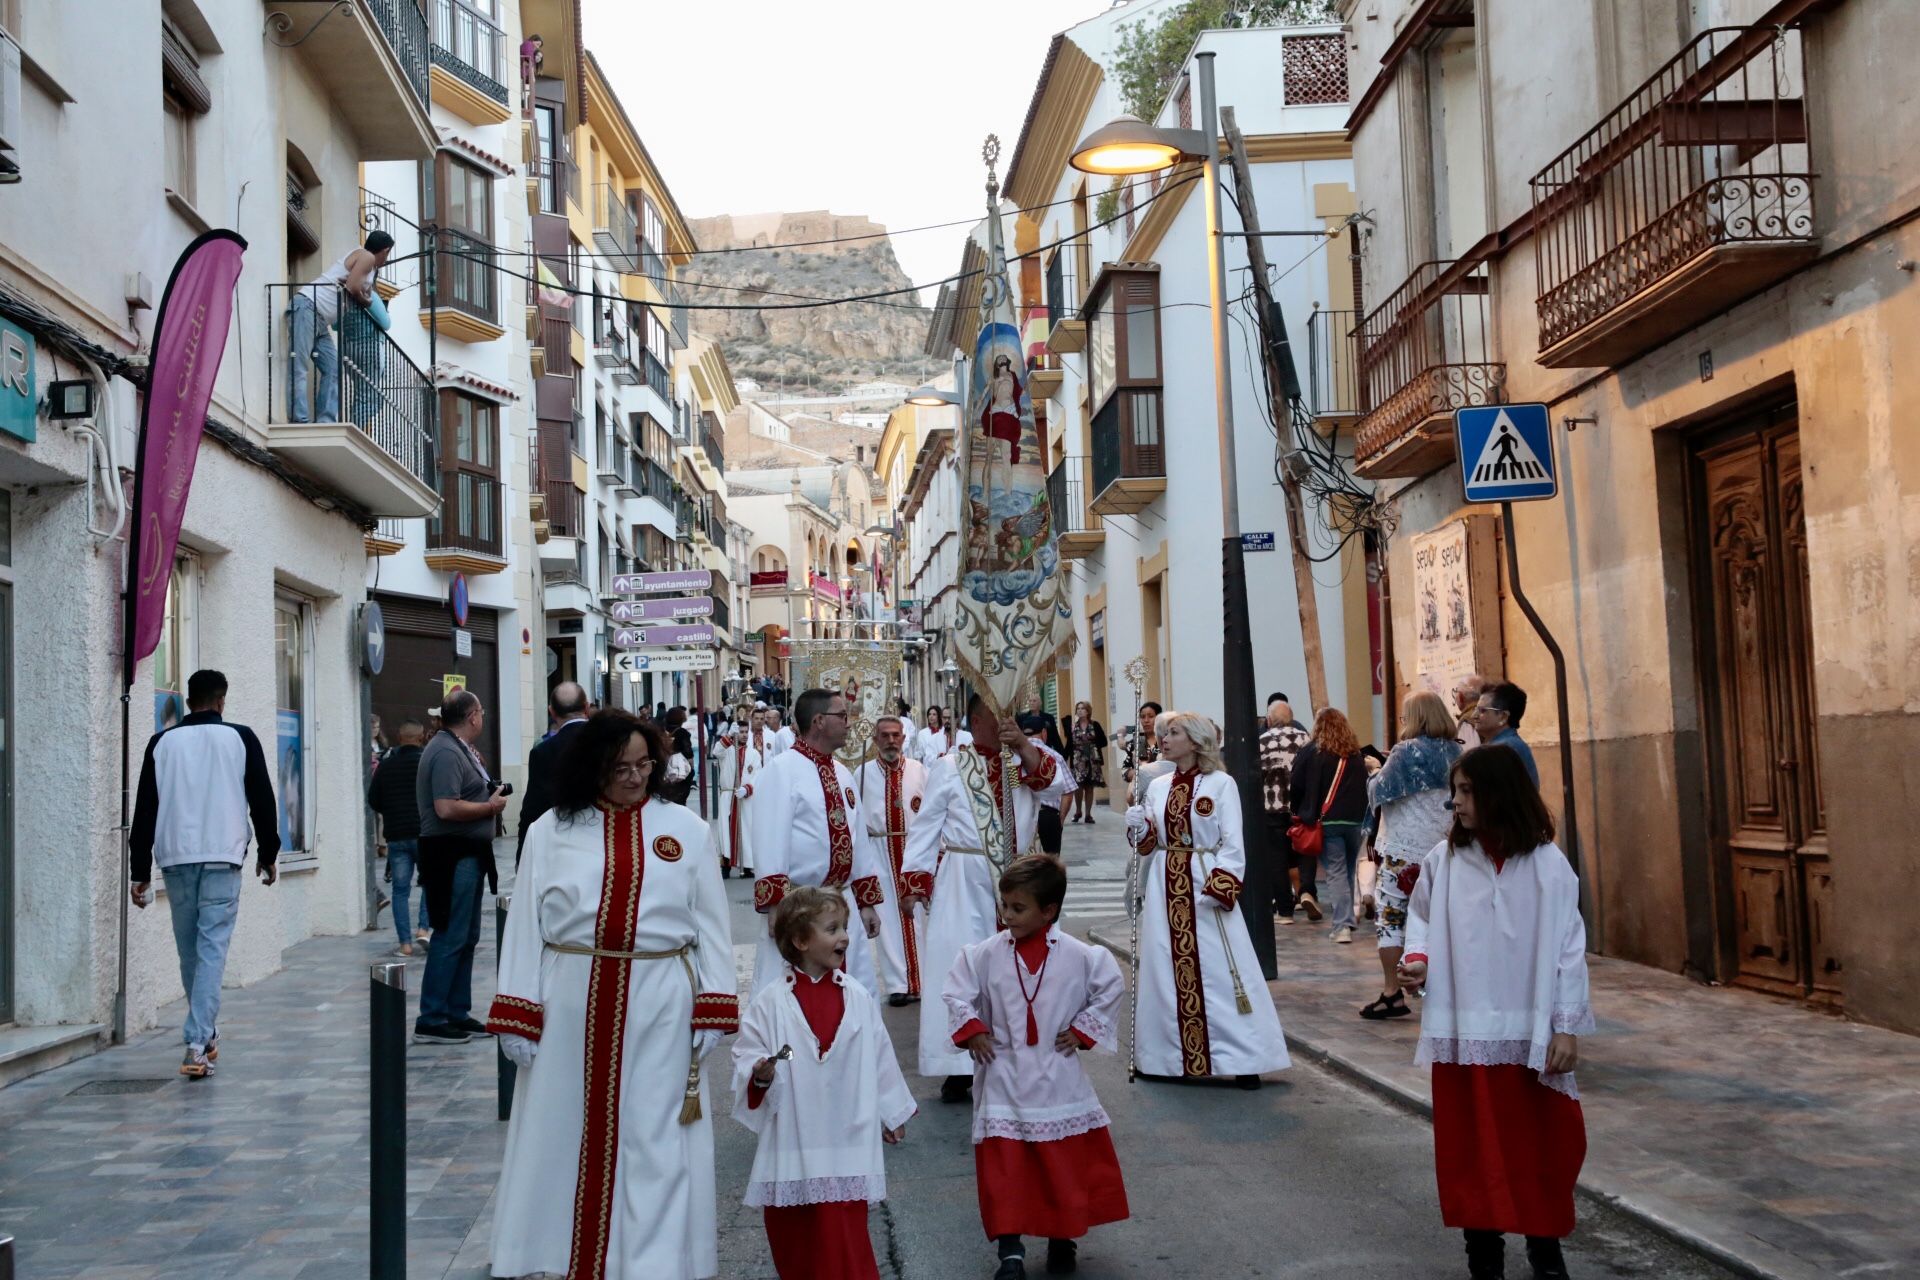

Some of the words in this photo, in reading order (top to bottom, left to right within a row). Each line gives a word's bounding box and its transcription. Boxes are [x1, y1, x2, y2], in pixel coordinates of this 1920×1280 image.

[644, 579, 709, 591] ayuntamiento
[673, 604, 710, 617] juzgado
[676, 632, 712, 642] castillo
